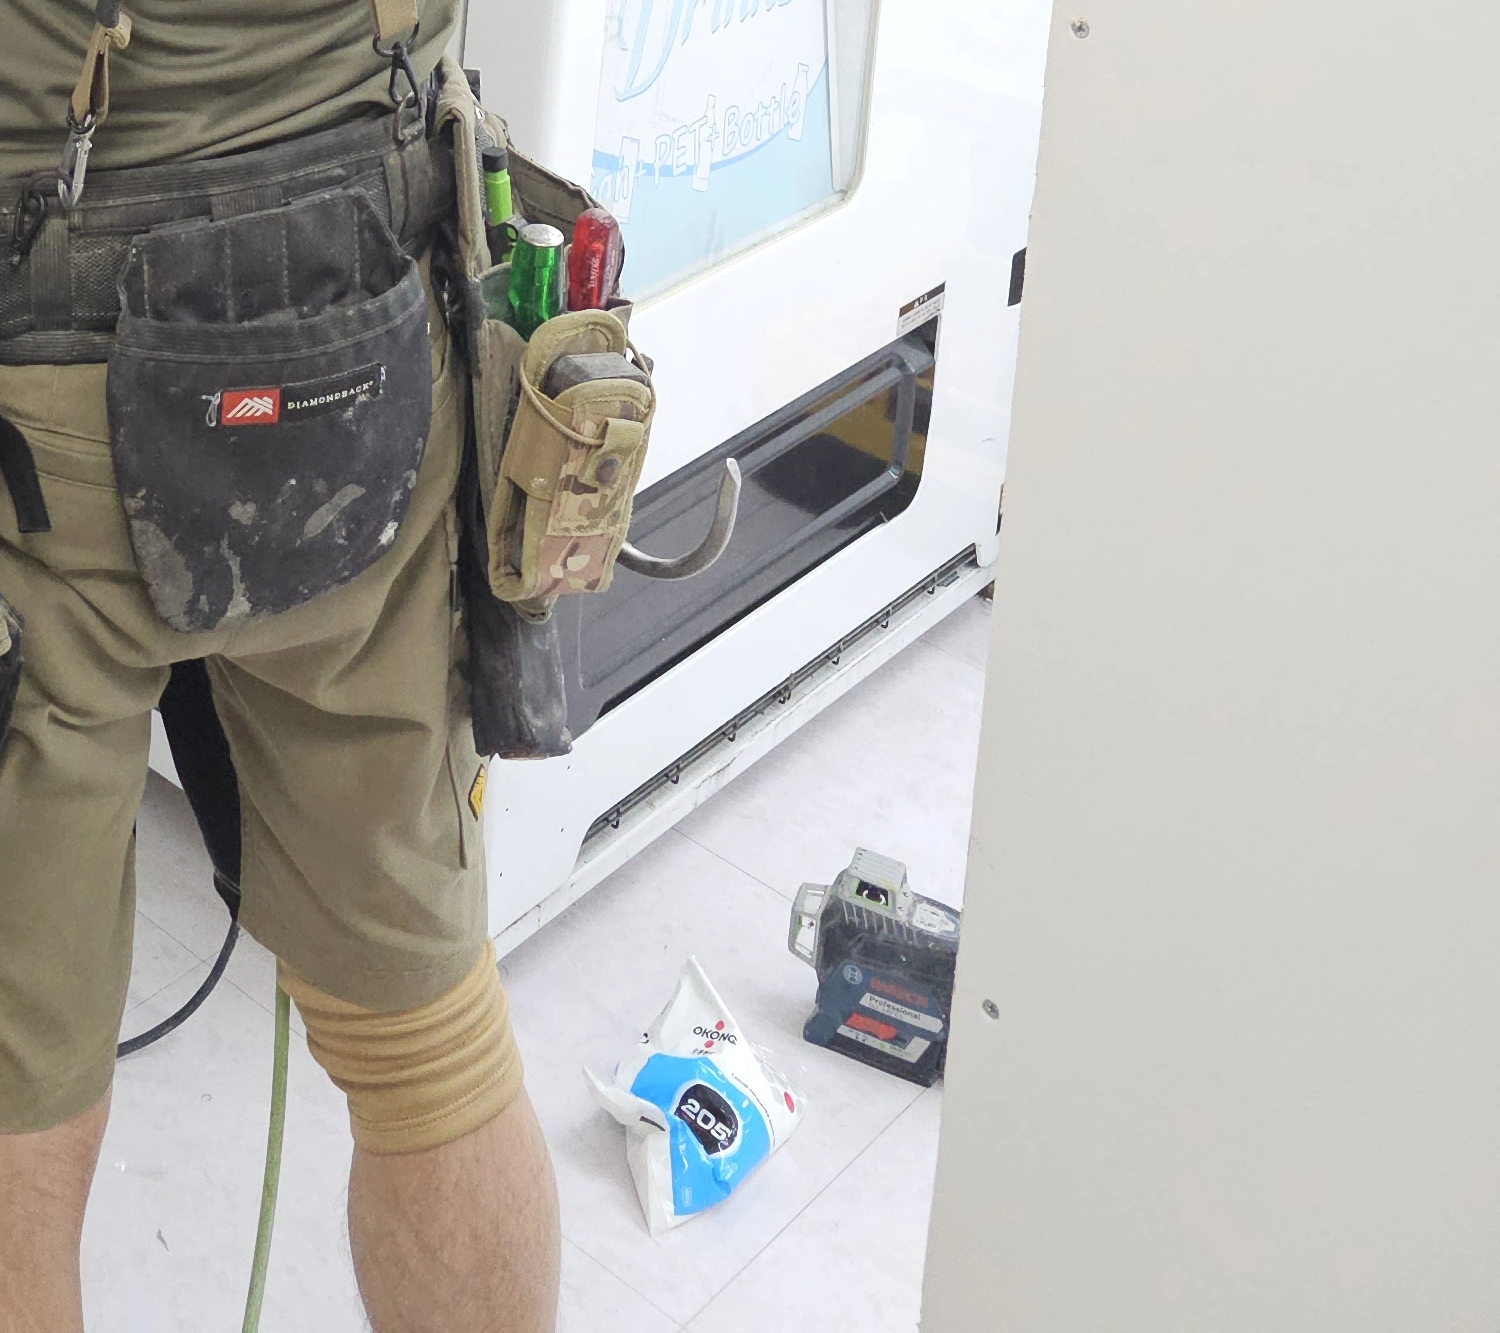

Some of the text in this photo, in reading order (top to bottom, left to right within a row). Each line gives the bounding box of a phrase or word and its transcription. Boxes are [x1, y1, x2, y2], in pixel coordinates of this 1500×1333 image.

[868, 995, 922, 1021] Professional
[692, 1025, 738, 1046] OKONG
[680, 1097, 733, 1142] 205
